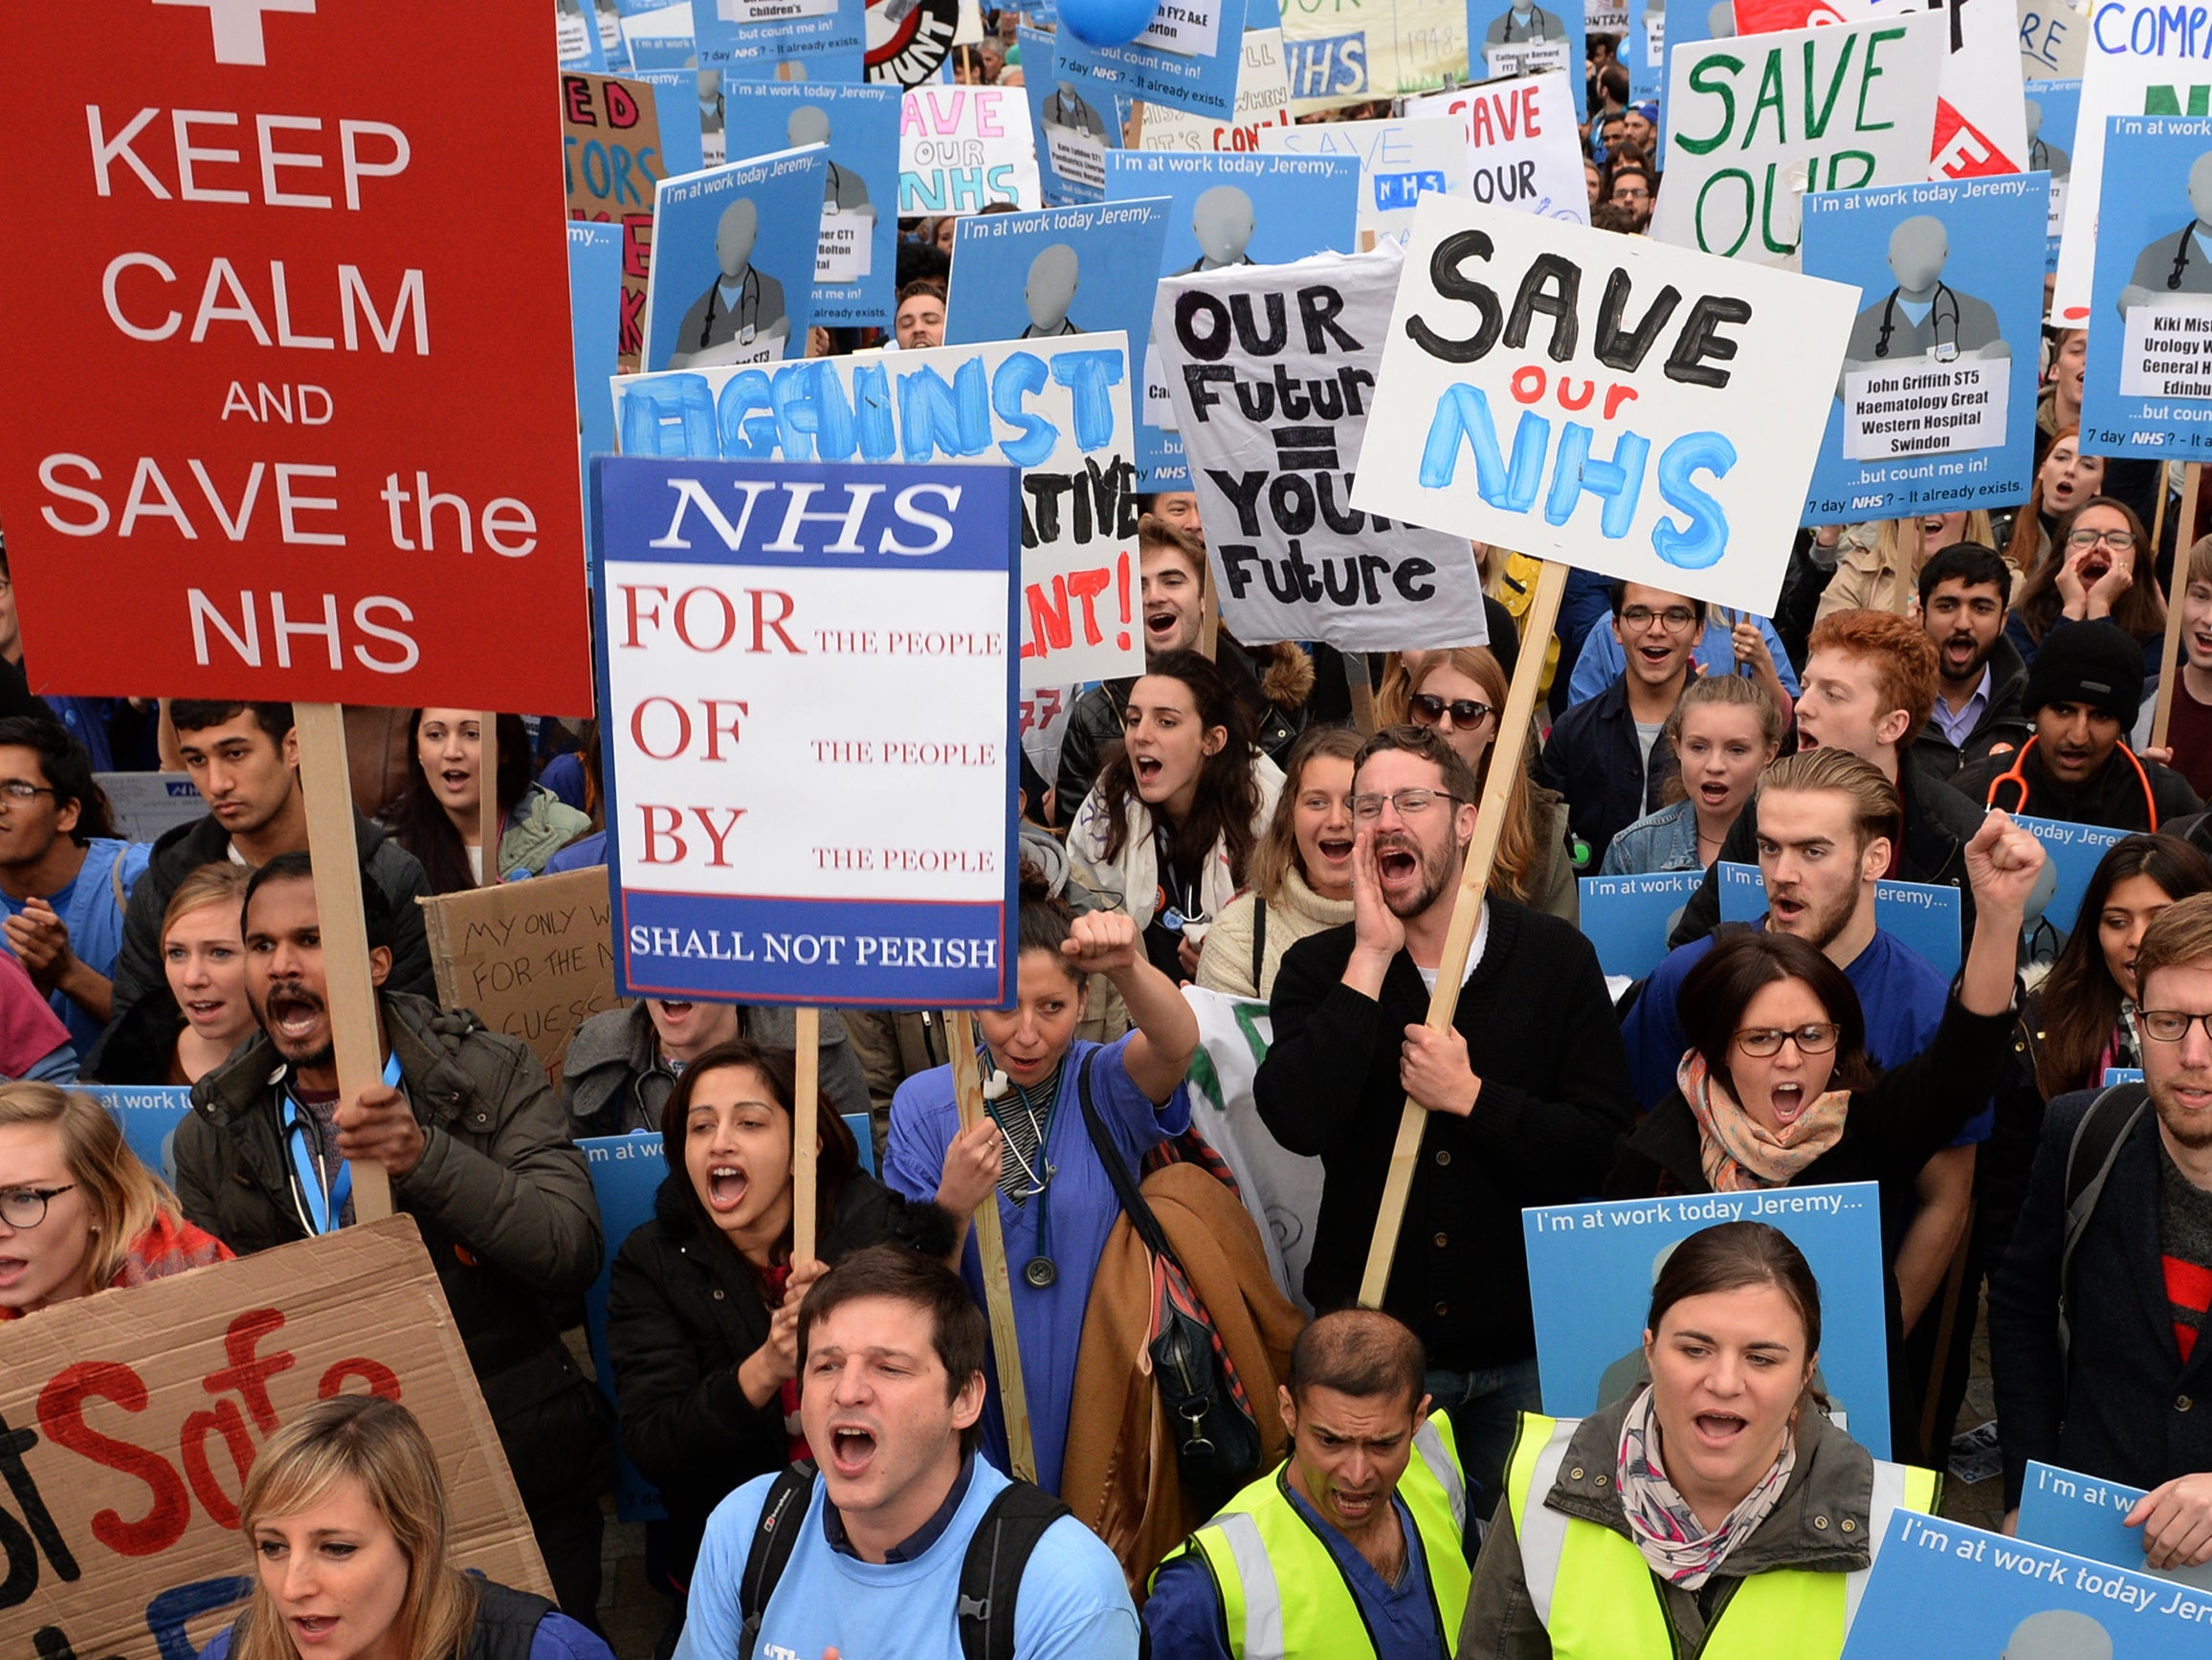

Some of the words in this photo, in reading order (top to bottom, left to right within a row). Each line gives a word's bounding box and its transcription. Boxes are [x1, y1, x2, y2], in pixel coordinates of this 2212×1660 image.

[749, 4, 802, 17] Children's
[1167, 9, 1185, 22] FY2
[1187, 13, 1207, 27] A&E
[761, 25, 793, 38] count
[796, 23, 816, 34] me
[818, 20, 833, 32] in!
[2019, 11, 2068, 62] RE
[712, 51, 730, 62] day
[785, 40, 825, 53] already
[869, 11, 955, 84] HUNT
[1123, 52, 1158, 68] count
[1161, 59, 1182, 75] me
[1184, 62, 1201, 78] in!
[732, 83, 752, 95] I'm
[755, 84, 768, 96] at
[769, 84, 802, 97] work
[804, 85, 836, 100] today
[839, 86, 895, 101] Jeremy...
[1059, 57, 1066, 68] 7
[1069, 60, 1089, 77] day
[1147, 79, 1190, 100] already
[1192, 91, 1228, 109] exists.
[1235, 87, 1288, 112] WHEN
[1674, 28, 1907, 156] SAVE
[2115, 118, 2142, 134] I'm
[2147, 120, 2163, 134] at
[2168, 120, 2211, 135] work
[86, 104, 411, 210] KEEP
[914, 139, 985, 167] OUR
[1115, 154, 1142, 170] I'm
[1147, 156, 1163, 172] at
[1169, 155, 1213, 172] work
[1218, 156, 1265, 176] today
[1270, 157, 1348, 176] Jeremy...
[666, 188, 687, 205] I'm
[690, 181, 702, 198] at
[704, 173, 734, 194] work
[736, 166, 768, 187] today
[770, 156, 822, 178] Jeremy...
[899, 165, 1019, 211] NHS
[1473, 161, 1537, 204] OUR
[1813, 195, 1839, 213] I'm
[1845, 193, 1865, 210] at
[1869, 189, 1908, 209] work
[1913, 185, 1958, 208] today
[1962, 179, 2040, 203] Jeremy...
[1695, 150, 1876, 256] OUR
[836, 230, 854, 240] CT1
[964, 221, 988, 239] I'm
[993, 222, 1007, 237] at
[1012, 216, 1049, 235] work
[1053, 211, 1094, 231] today
[1096, 206, 1161, 226] Jeremy...
[818, 245, 852, 255] Bolton
[101, 252, 430, 356] CALM
[826, 290, 844, 299] me
[848, 289, 861, 299] in!
[1405, 230, 1752, 388] SAVE
[814, 308, 852, 319] already
[1175, 285, 1365, 362] OUR
[2154, 317, 2180, 331] Kiki
[2144, 338, 2201, 354] Urology
[1867, 378, 1899, 394] John
[1902, 373, 1951, 390] Griffith
[1954, 370, 1980, 386] ST5
[2142, 359, 2199, 374] General
[221, 381, 334, 425] AND
[619, 348, 1124, 466] AGAINST
[1510, 365, 1639, 420] our
[1856, 394, 1948, 416] Haematology
[1951, 390, 1989, 408] Great
[1862, 415, 1920, 436] Western
[1924, 411, 1981, 430] Hospital
[2129, 404, 2169, 420] ...but
[1891, 434, 1950, 453] Swindon
[2088, 430, 2096, 441] 7
[2100, 431, 2125, 446] day
[2191, 433, 2200, 447] It
[1155, 467, 1187, 478] NHS
[1419, 383, 1737, 569] NHS
[1847, 469, 1886, 486] ...but
[1891, 463, 1934, 481] count
[1938, 461, 1964, 476] me
[1968, 457, 1989, 473] in!
[37, 453, 346, 546] SAVE
[381, 471, 537, 558] the
[1204, 470, 1427, 537] YOU
[1808, 501, 1817, 513] 7
[1822, 499, 1846, 514] day
[1910, 490, 1918, 504] It
[1922, 484, 1975, 501] already
[1979, 480, 2024, 496] exists.
[649, 478, 962, 556] NHS
[1219, 539, 1436, 607] Future
[617, 584, 807, 655] FOR
[814, 630, 879, 655] THE
[888, 631, 1002, 656] PEOPLE
[1021, 550, 1132, 658] NT!
[188, 588, 420, 674] NHS
[630, 697, 749, 762] OF
[810, 740, 874, 764] THE
[882, 741, 996, 765] PEOPLE
[635, 803, 748, 868] BY
[812, 847, 874, 872] THE
[883, 849, 994, 873] PEOPLE
[2028, 821, 2074, 844] today
[1589, 879, 1615, 896] I'm
[1621, 878, 1637, 894] at
[1641, 876, 1682, 893] work
[1726, 867, 1750, 885] I'm
[1873, 885, 1948, 907] Jeremy...
[464, 916, 516, 956] MY
[525, 906, 576, 937] ONLY
[630, 925, 754, 962] SHALL
[763, 932, 845, 964] NOT
[854, 935, 997, 969] PERISH
[473, 957, 532, 1002] FOR
[542, 946, 586, 977] THE
[123, 1093, 175, 1109] work
[615, 1142, 635, 1160] at
[1536, 1211, 1575, 1232] I'm
[1582, 1210, 1604, 1229] at
[1609, 1204, 1671, 1227] work
[1678, 1201, 1743, 1221] today
[1750, 1193, 1863, 1217] Jeremy...
[2039, 1470, 2076, 1498] I'm
[2083, 1485, 2106, 1507] at
[1901, 1517, 1949, 1552] I'm
[1956, 1538, 1986, 1561] at
[1994, 1550, 2069, 1585] work
[2075, 1572, 2157, 1612] today
[2159, 1591, 2212, 1625] Jer
